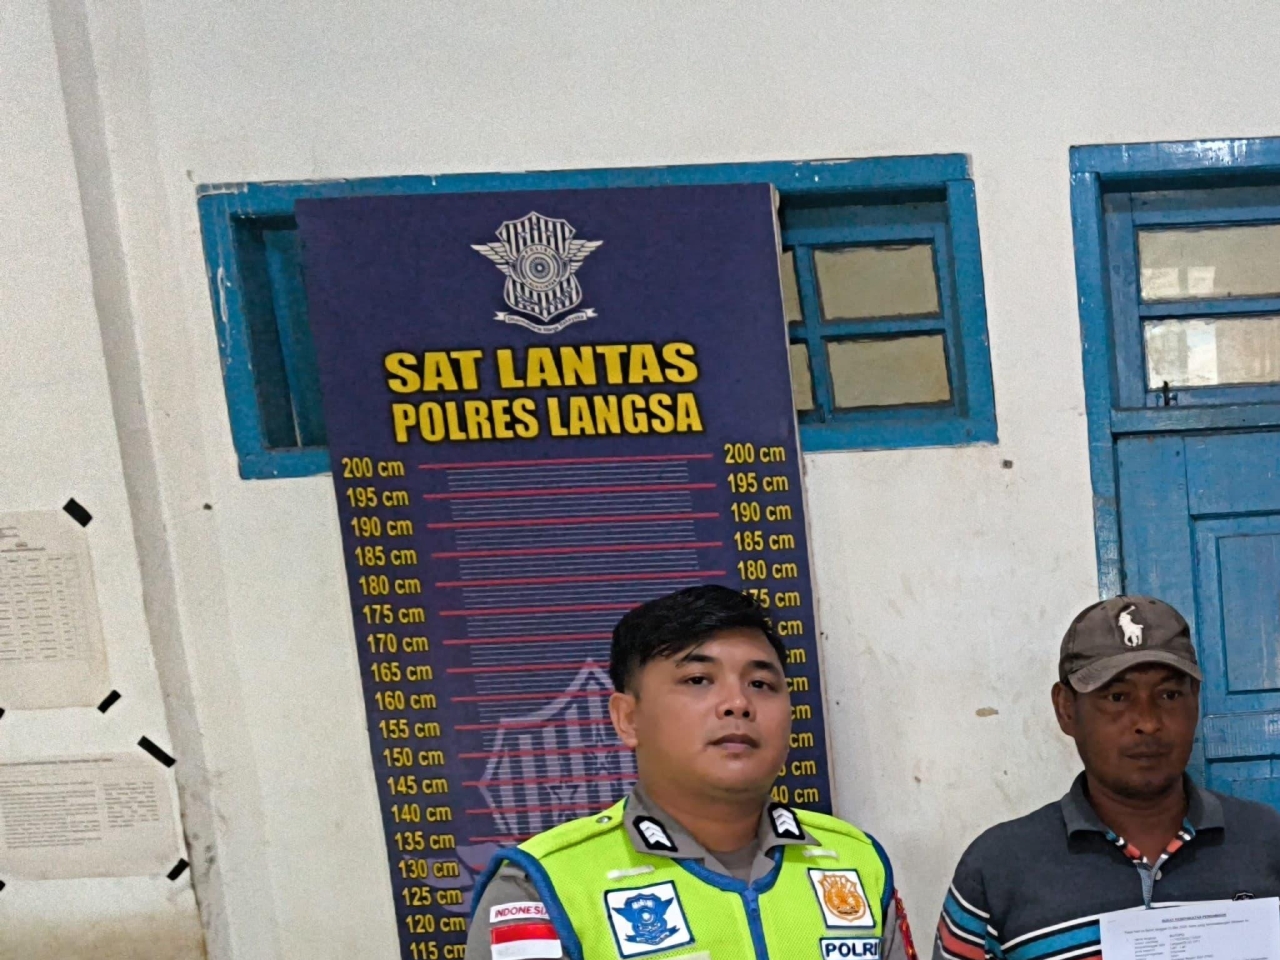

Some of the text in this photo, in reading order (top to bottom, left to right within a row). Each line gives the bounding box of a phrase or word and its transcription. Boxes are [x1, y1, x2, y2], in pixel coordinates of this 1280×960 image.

[384, 342, 698, 393] SAT LANTAS
[392, 392, 703, 443] POLRES LANGSA
[724, 443, 786, 464] 200 cm
[341, 456, 405, 478] 200 cm
[727, 472, 789, 493] 195 cm
[346, 486, 410, 508] 195 cm
[731, 502, 792, 522] 190 cm
[351, 516, 414, 538] 190 cm
[734, 531, 795, 551] 185 cm
[355, 545, 418, 567] 185 cm
[737, 560, 798, 580] 180 cm
[359, 574, 422, 596] 180 cm
[741, 588, 801, 608] 75 cm
[362, 603, 426, 624] 175 cm
[778, 620, 803, 636] cm
[367, 632, 429, 653] 170 cm
[370, 661, 433, 683] 165 cm
[375, 690, 437, 711] 160 cm
[379, 718, 441, 739] 155 cm
[789, 732, 814, 748] cm
[383, 747, 445, 768] 150 cm
[791, 760, 817, 776] cm
[387, 774, 449, 795] 145 cm
[770, 785, 819, 804] 40 cm
[391, 803, 453, 823] 140 cm
[394, 831, 456, 851] 135 cm
[398, 858, 459, 879] 130 cm
[402, 886, 463, 906] 125 cm
[405, 913, 466, 934] 120 cm
[409, 941, 468, 960] 115 cm
[825, 942, 878, 957] POLRI
